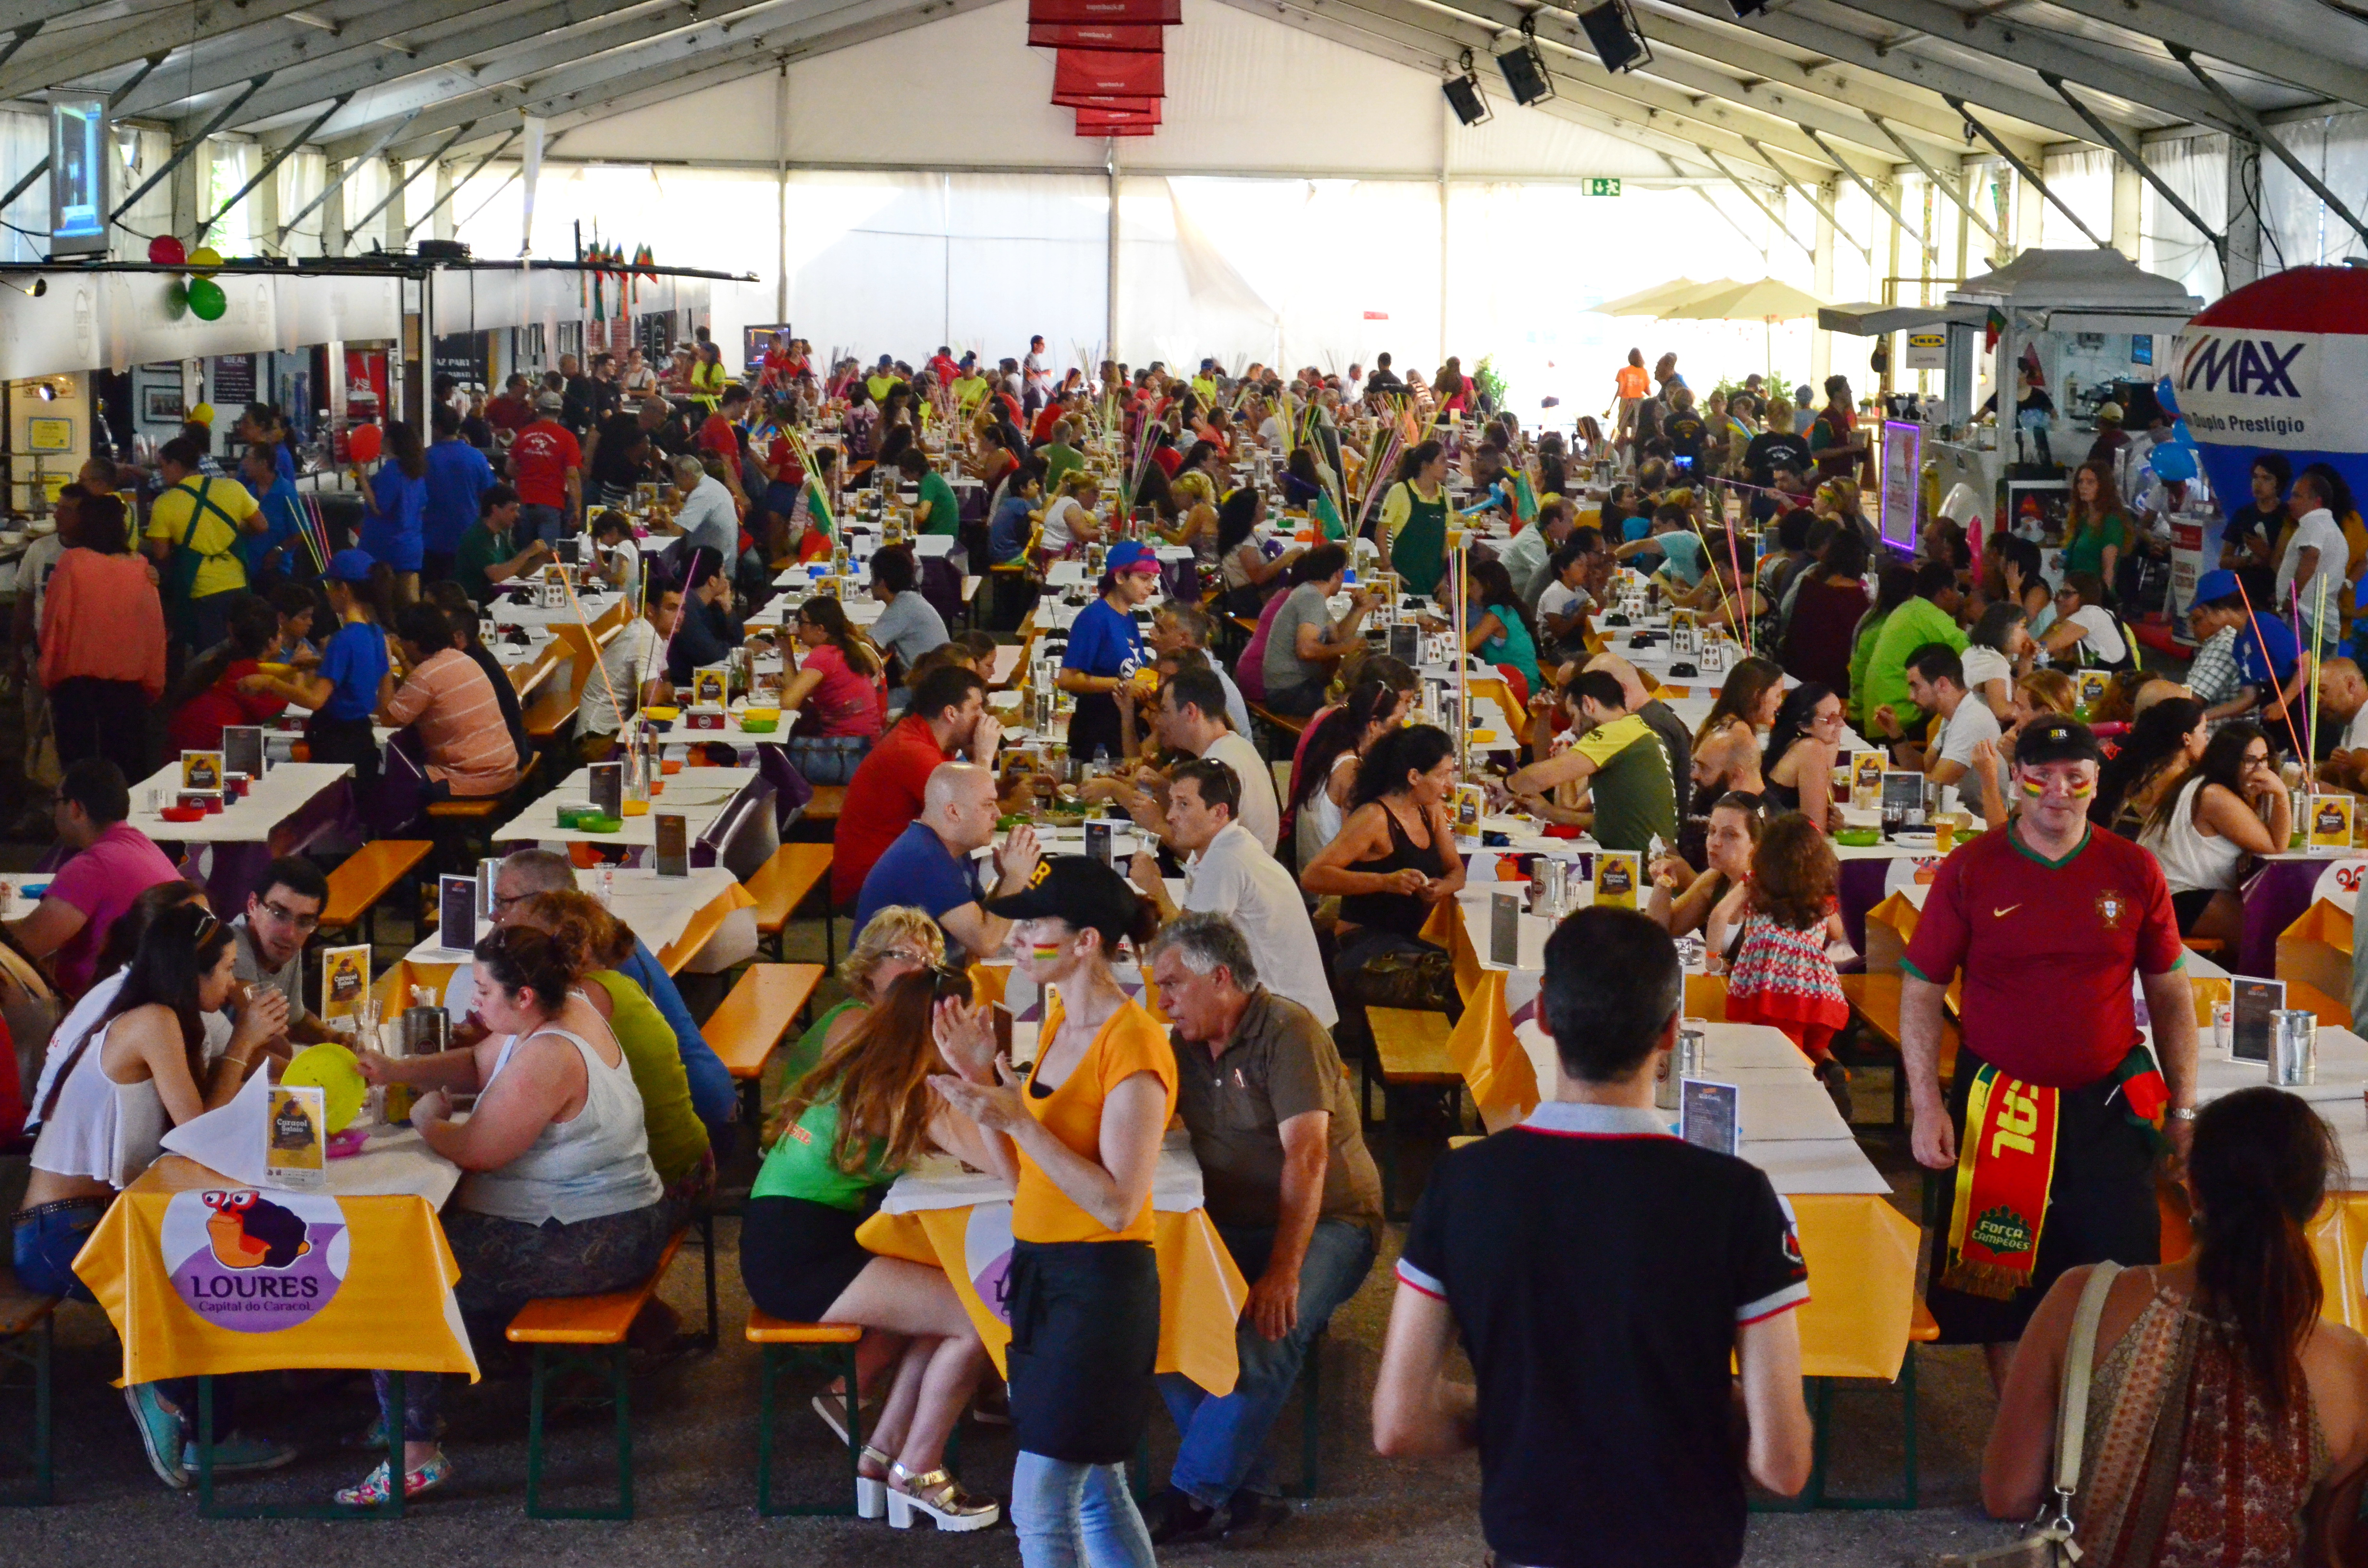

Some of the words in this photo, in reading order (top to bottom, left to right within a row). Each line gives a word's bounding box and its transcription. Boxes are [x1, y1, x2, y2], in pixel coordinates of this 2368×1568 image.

[2228, 415, 2305, 436] Prestígio
[276, 1118, 308, 1127] Caracol
[190, 1275, 319, 1298] LOURES
[199, 1300, 242, 1313] Capital
[245, 1301, 261, 1311] do
